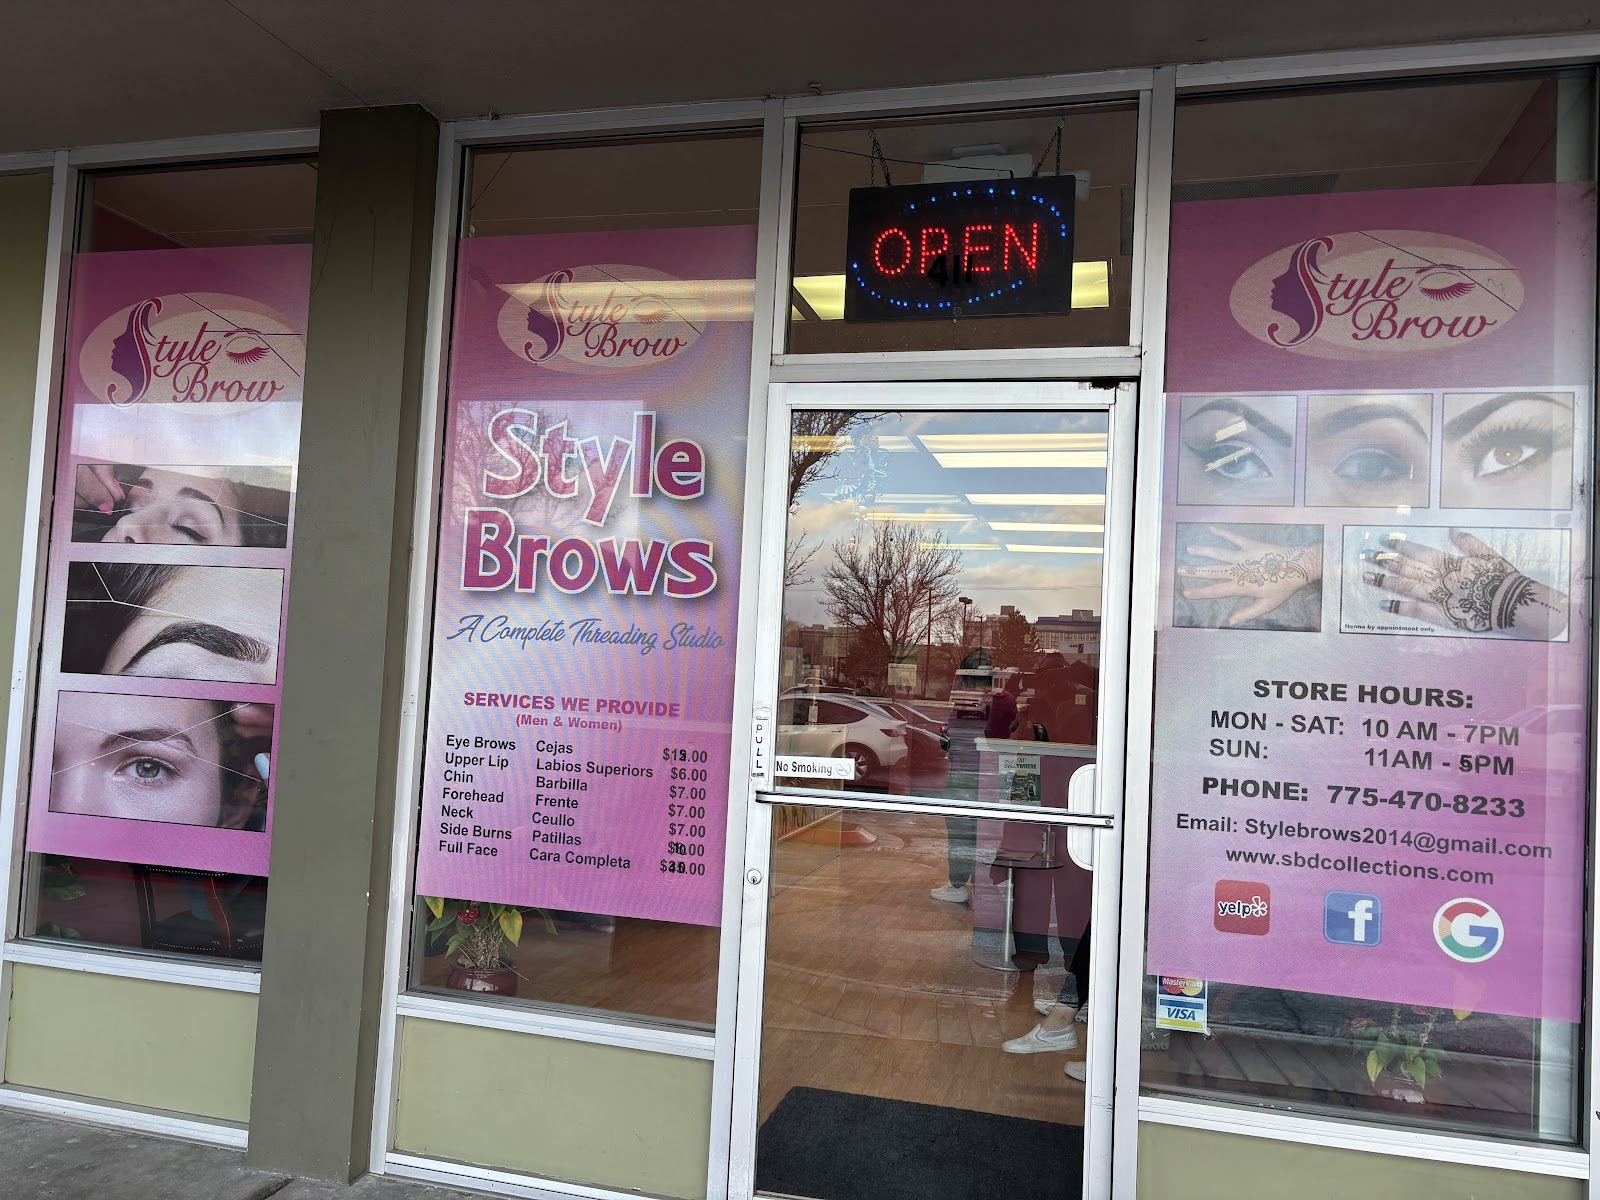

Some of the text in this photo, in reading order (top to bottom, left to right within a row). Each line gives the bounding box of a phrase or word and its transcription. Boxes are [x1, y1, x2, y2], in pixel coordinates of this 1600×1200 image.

[873, 222, 1039, 275] OPEN
[1267, 235, 1413, 348] Style
[523, 269, 629, 363] Style
[1351, 299, 1498, 341] Brow
[107, 297, 222, 408] Style
[584, 322, 688, 359] Brow
[172, 361, 285, 404] Brow
[482, 407, 706, 528] Style
[459, 506, 719, 600] Brows
[447, 614, 725, 656] A Complete Threading Studio
[463, 691, 681, 717] SERVICES WE PROVIDE
[1253, 679, 1474, 709] STORE HOURS:
[516, 714, 623, 733] (Men & Women)
[1210, 710, 1268, 731] MON
[1290, 713, 1345, 736] SAT:
[1362, 717, 1390, 738] 10
[1396, 720, 1438, 741] AM
[1463, 724, 1520, 747] 7PM
[446, 734, 470, 750] Eye
[474, 736, 517, 751] Brows
[535, 740, 574, 756] Cejas
[755, 723, 763, 769] PULL
[1209, 738, 1269, 760] SUN:
[1364, 747, 1433, 771] 11AM
[445, 751, 708, 782] Upper Lip Labios Superiors $6.00
[776, 760, 833, 777] No Smoking
[443, 769, 707, 801] Chin Barbilla $7.00
[1202, 776, 1526, 818] PHONE: 775-470-8233
[442, 787, 706, 819] Forehead Frente $7.00
[439, 822, 469, 836] Side
[472, 825, 513, 840] Burns
[531, 830, 582, 846] Patillas
[441, 804, 706, 838] Neck Ceullo $7.00
[1176, 813, 1553, 859] Email: Stylebrows2014@gmail.com
[438, 840, 463, 854] Full
[466, 843, 499, 857] Face
[529, 848, 561, 863] Cara
[565, 850, 631, 869] Completa
[1225, 849, 1495, 885] www.sbdcollections.com
[1218, 900, 1252, 918] yelp
[1162, 977, 1202, 988] MasterCard
[1166, 1007, 1197, 1021] VISA
